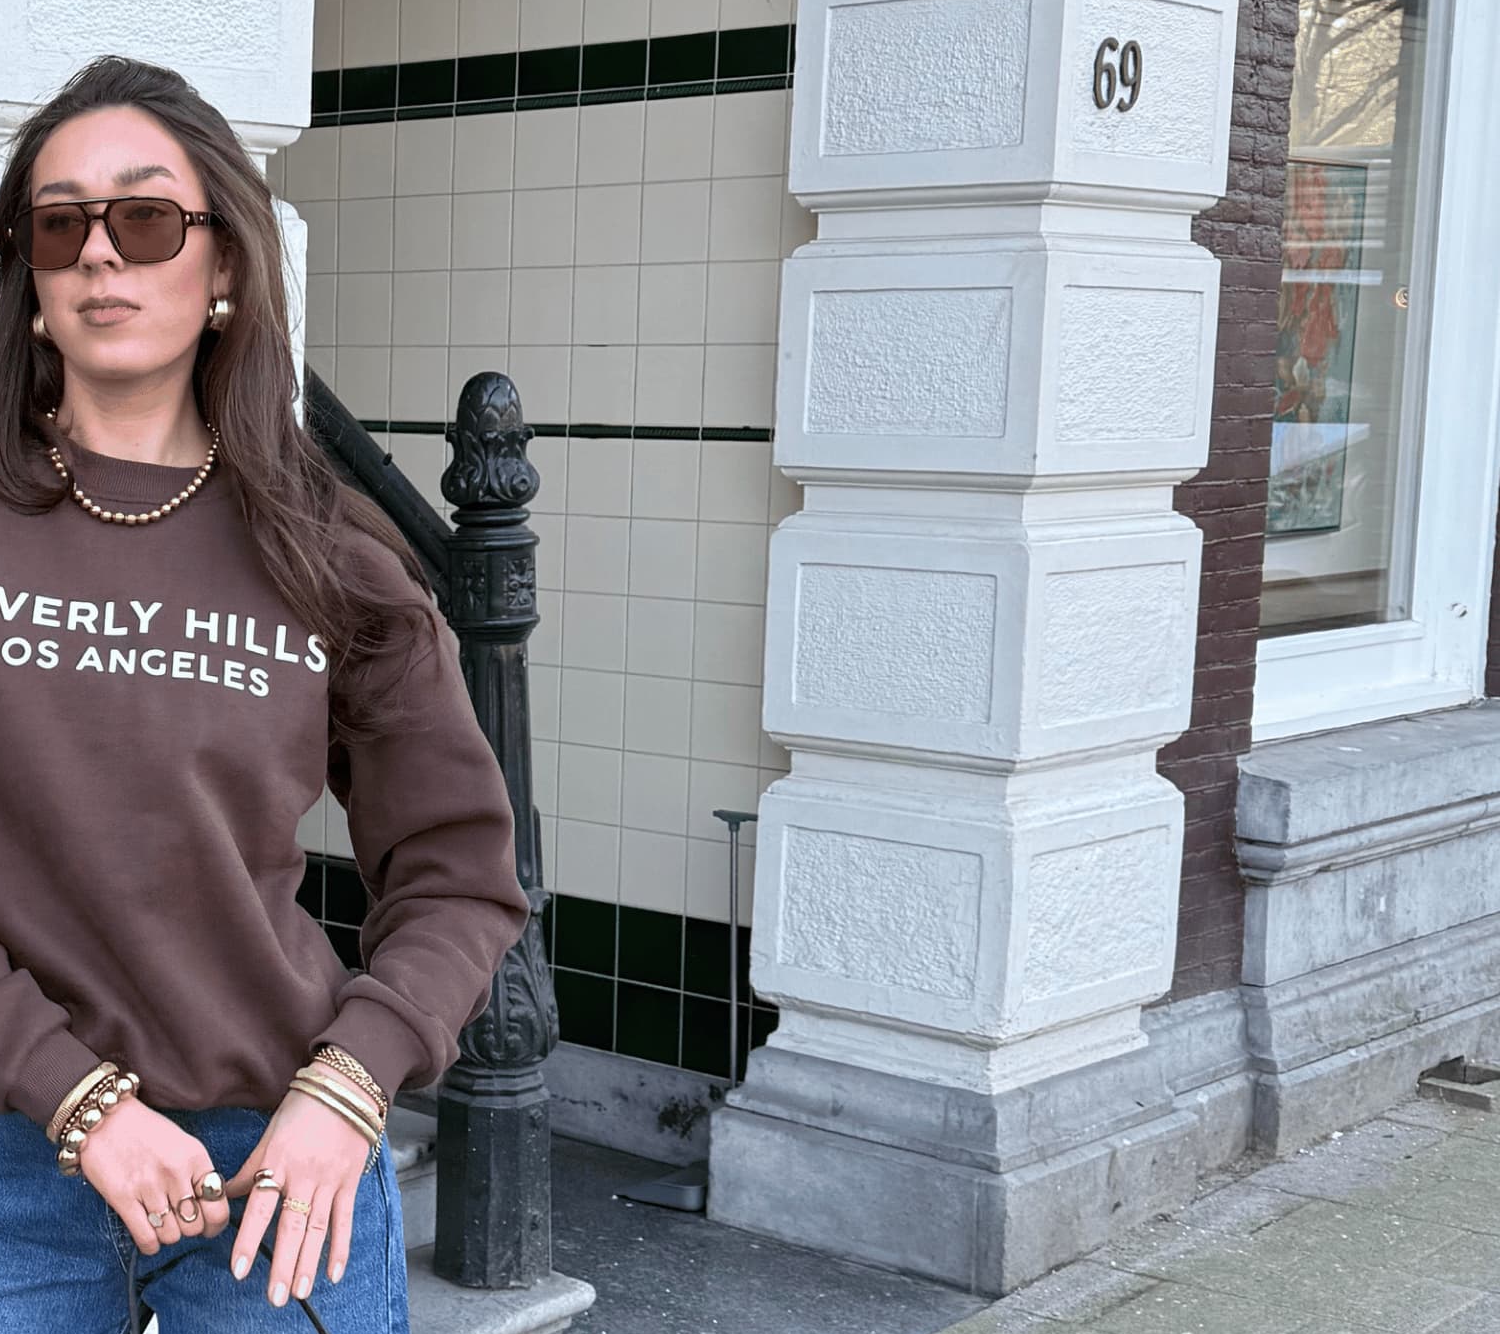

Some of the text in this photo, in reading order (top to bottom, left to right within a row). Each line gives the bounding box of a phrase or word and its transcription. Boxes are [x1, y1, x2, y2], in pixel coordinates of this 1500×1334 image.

[1093, 37, 1143, 112] 69
[75, 646, 270, 698] ANGELES
[185, 608, 327, 673] HILLS
